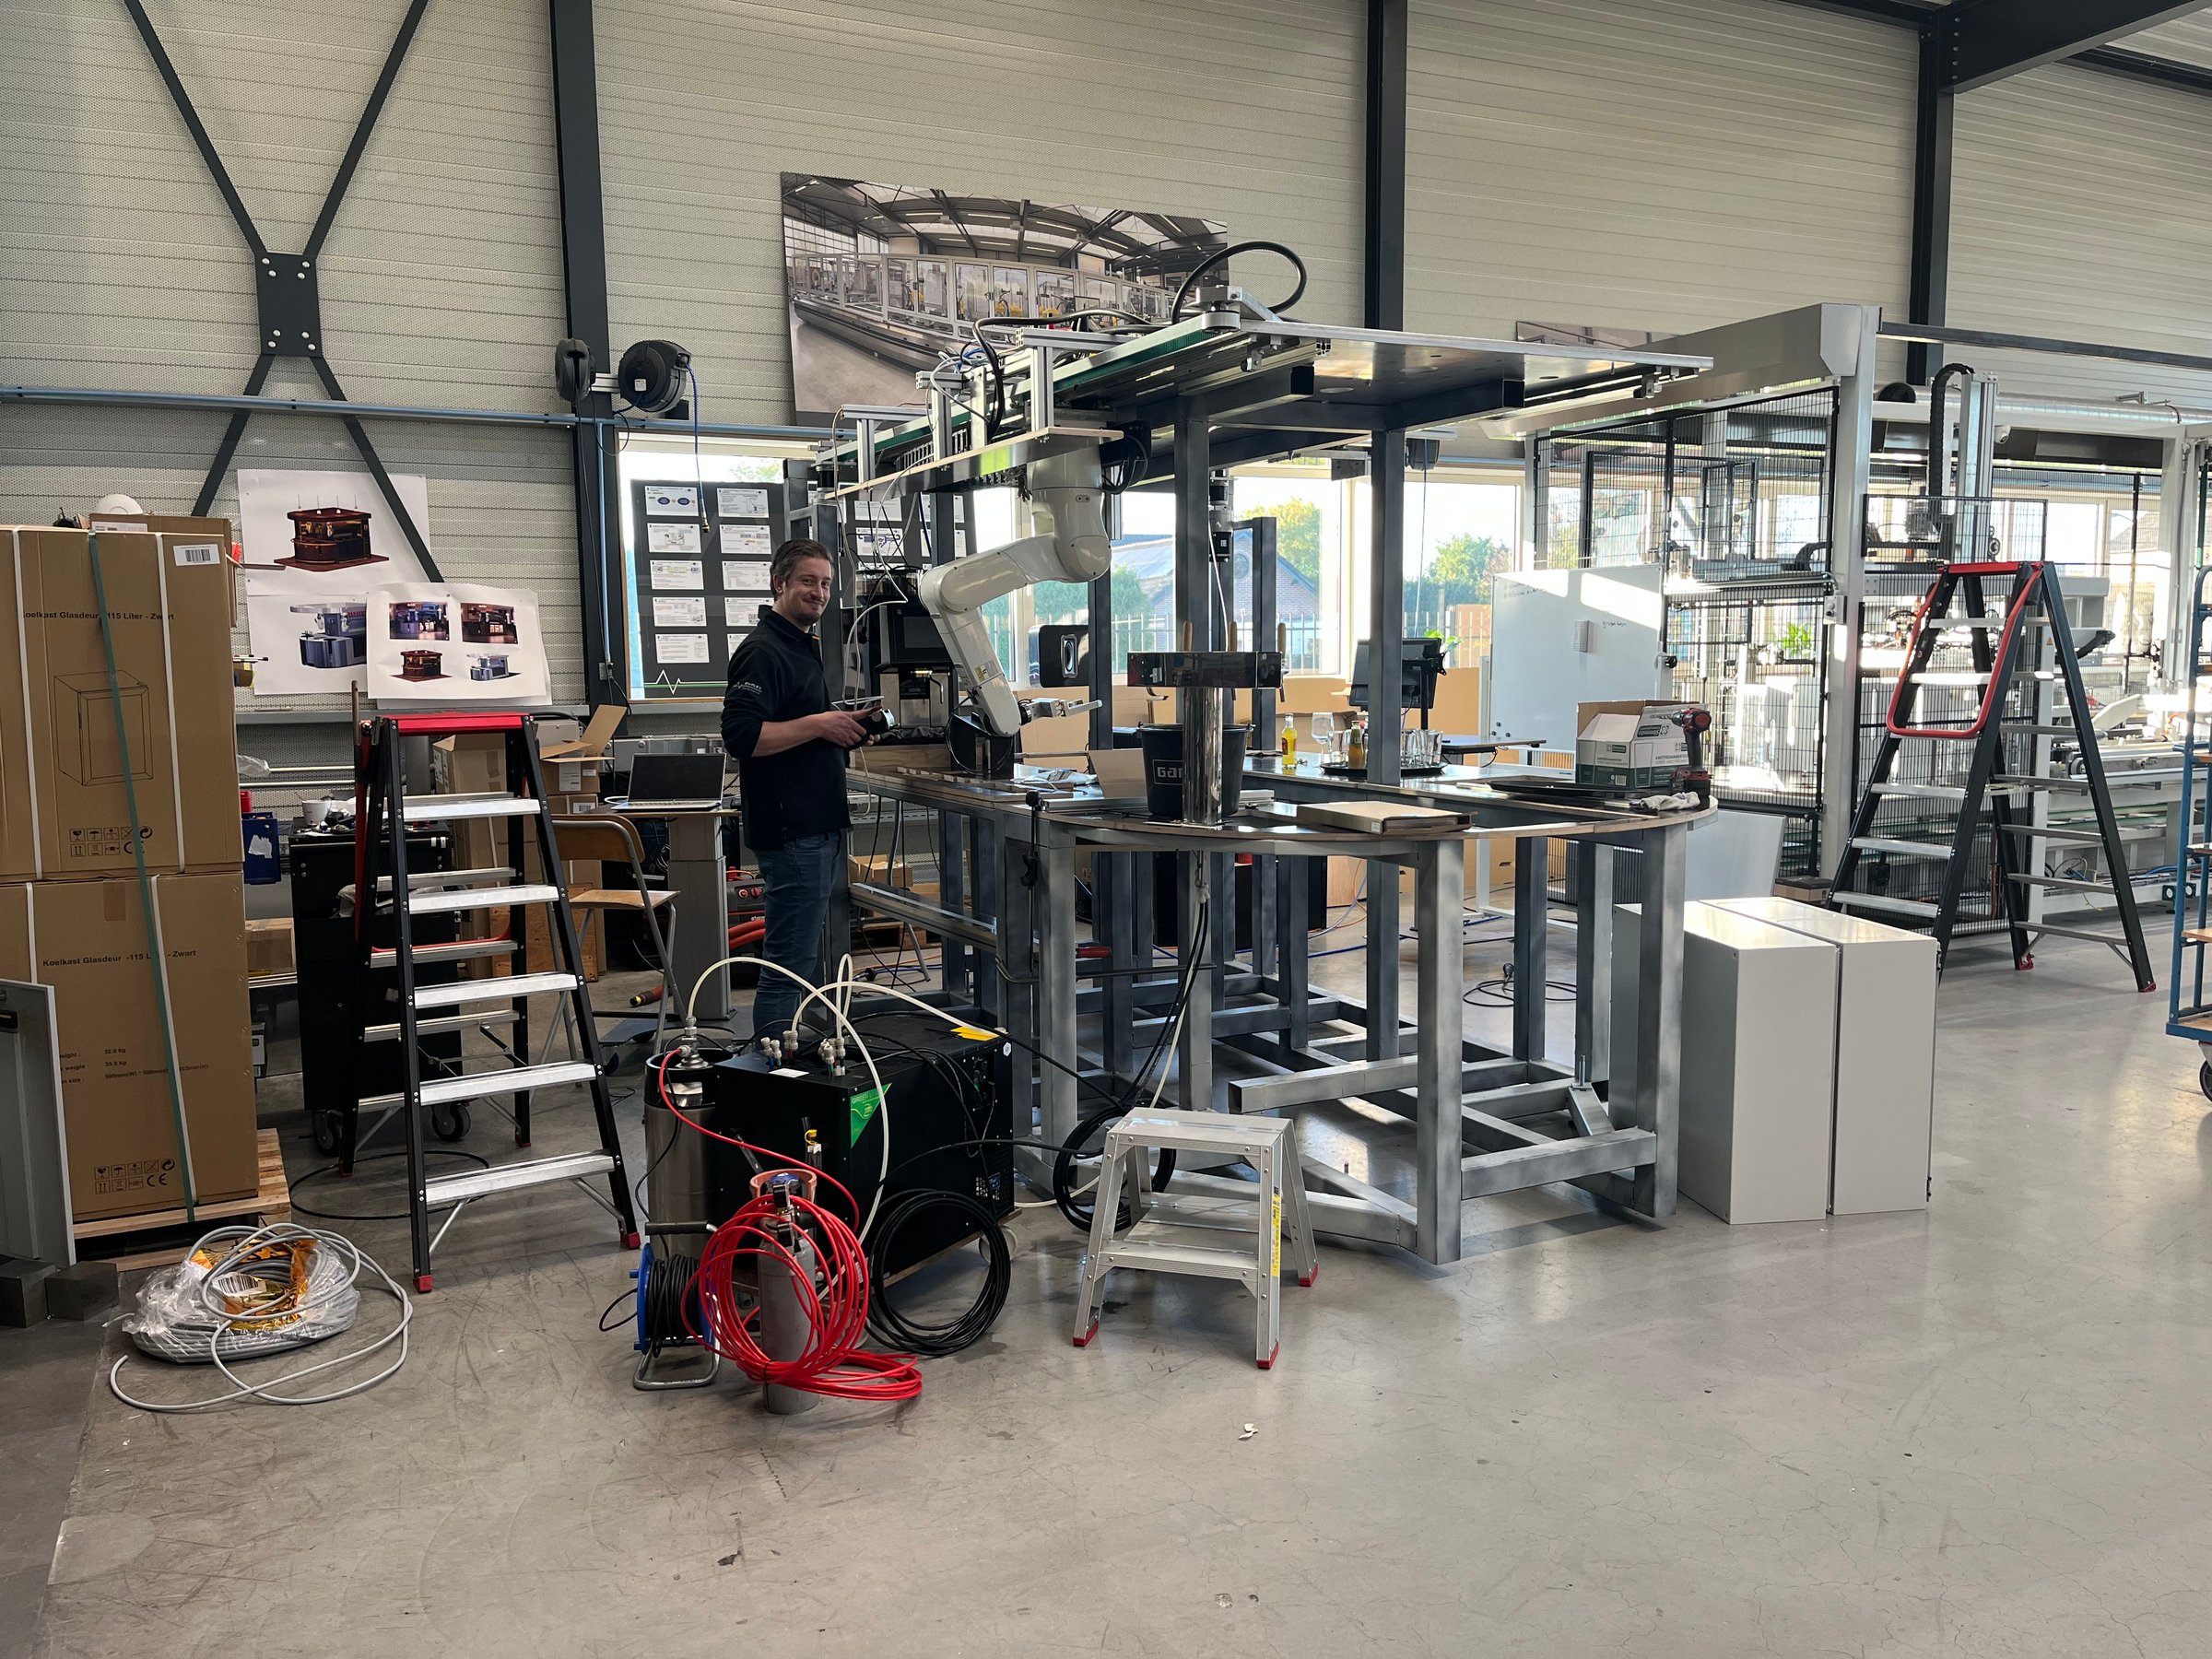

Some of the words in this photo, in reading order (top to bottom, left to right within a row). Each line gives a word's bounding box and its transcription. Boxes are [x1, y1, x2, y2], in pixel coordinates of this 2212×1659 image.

[59, 611, 100, 619] Glasdeur
[42, 958, 80, 967] Koelkast
[82, 955, 122, 964] Glasdeur
